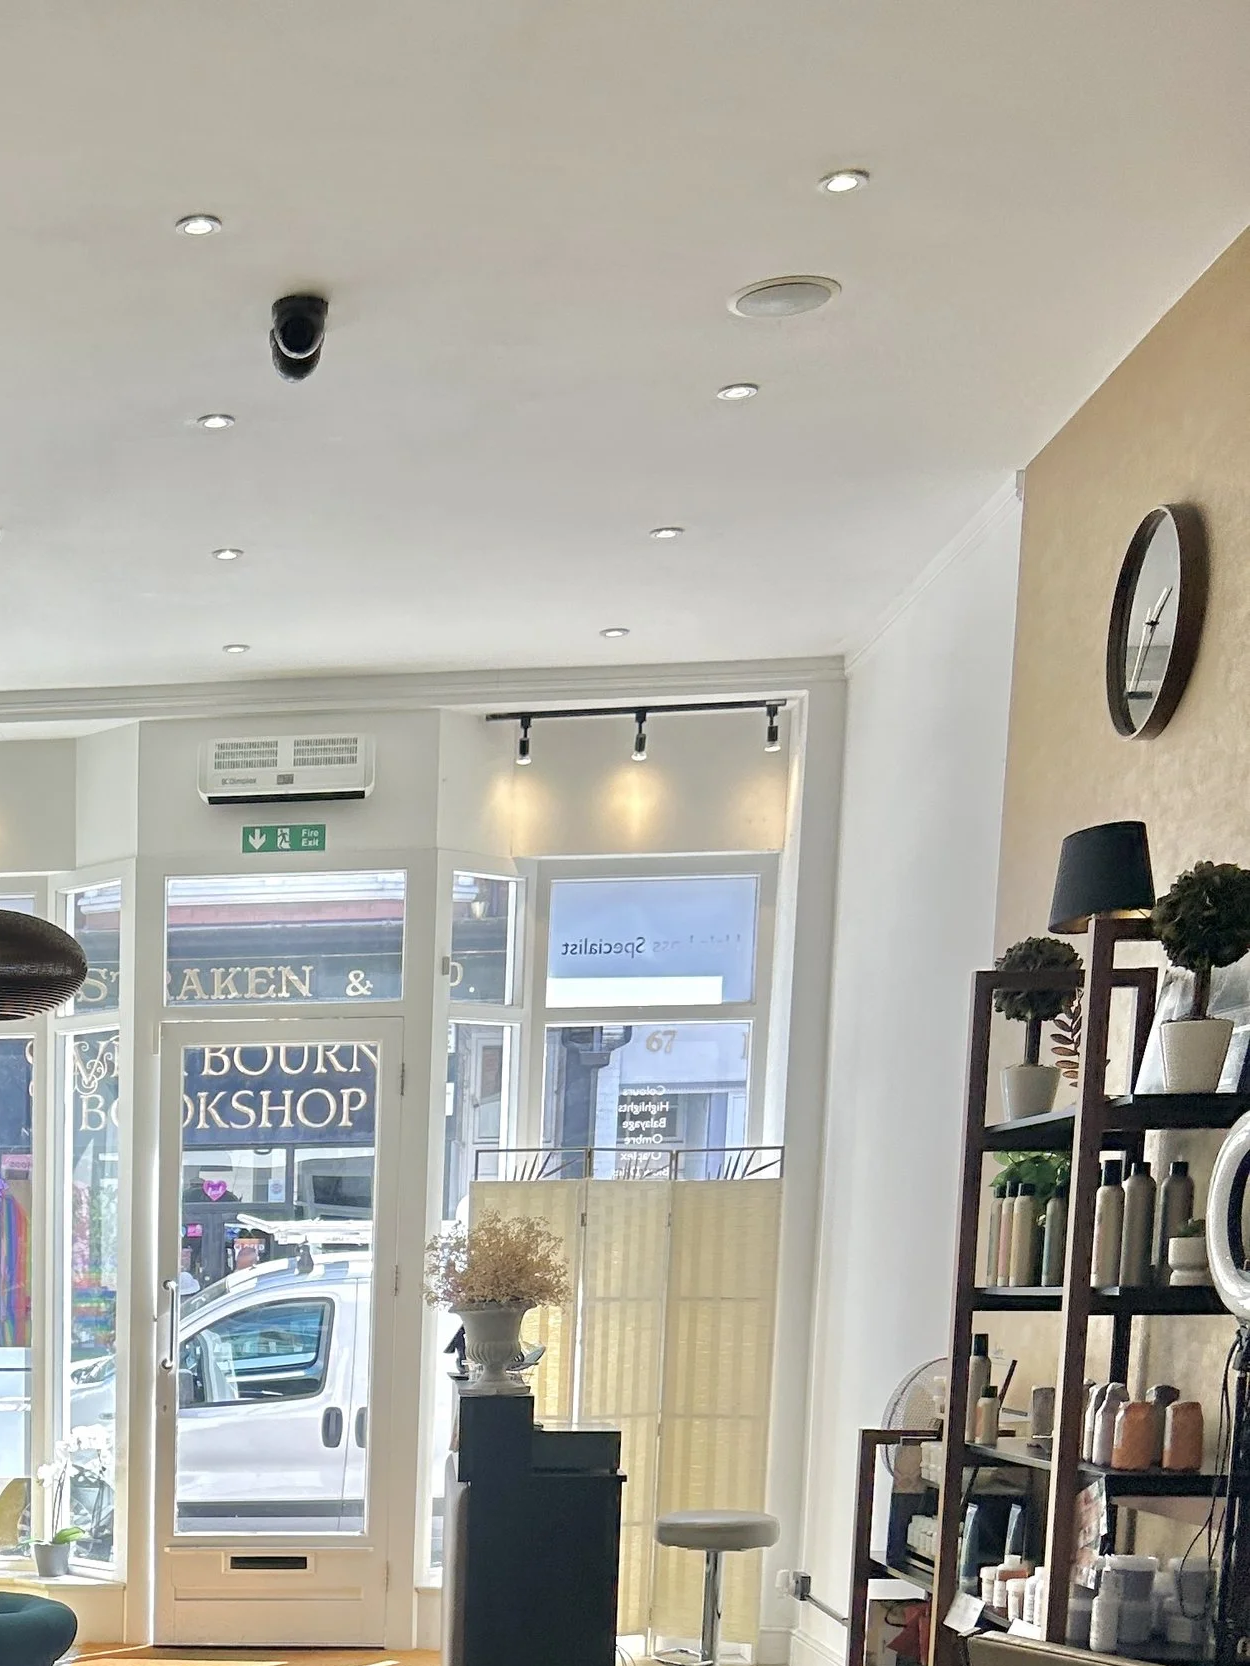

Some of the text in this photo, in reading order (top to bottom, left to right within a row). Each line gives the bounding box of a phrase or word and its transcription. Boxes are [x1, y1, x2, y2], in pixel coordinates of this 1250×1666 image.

[301, 828, 320, 838] Fire
[301, 837, 319, 847] Exit
[344, 968, 375, 998] &
[645, 1029, 678, 1054] 67
[78, 1087, 369, 1132] BKSHOP
